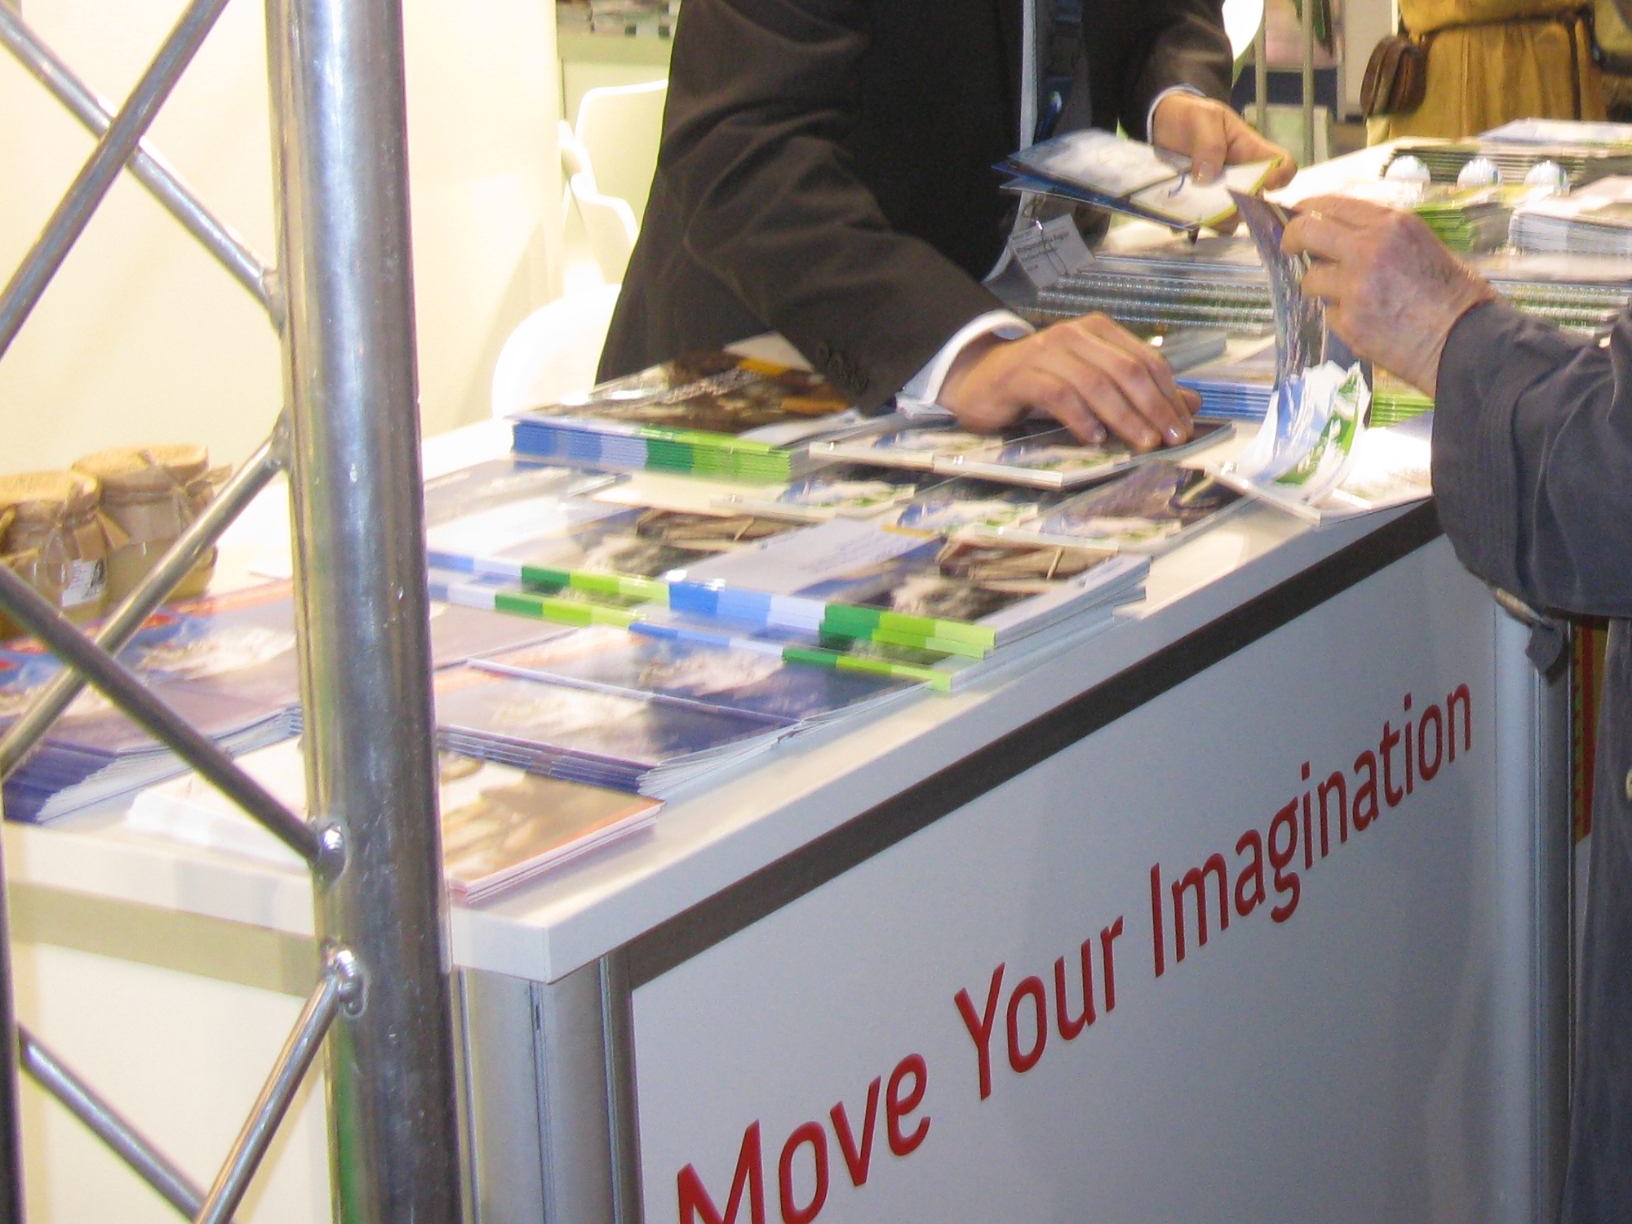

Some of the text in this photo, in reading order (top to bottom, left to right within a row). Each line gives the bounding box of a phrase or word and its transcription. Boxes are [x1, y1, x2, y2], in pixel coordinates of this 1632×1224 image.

[676, 682, 1471, 1224] Move Your Imagination
